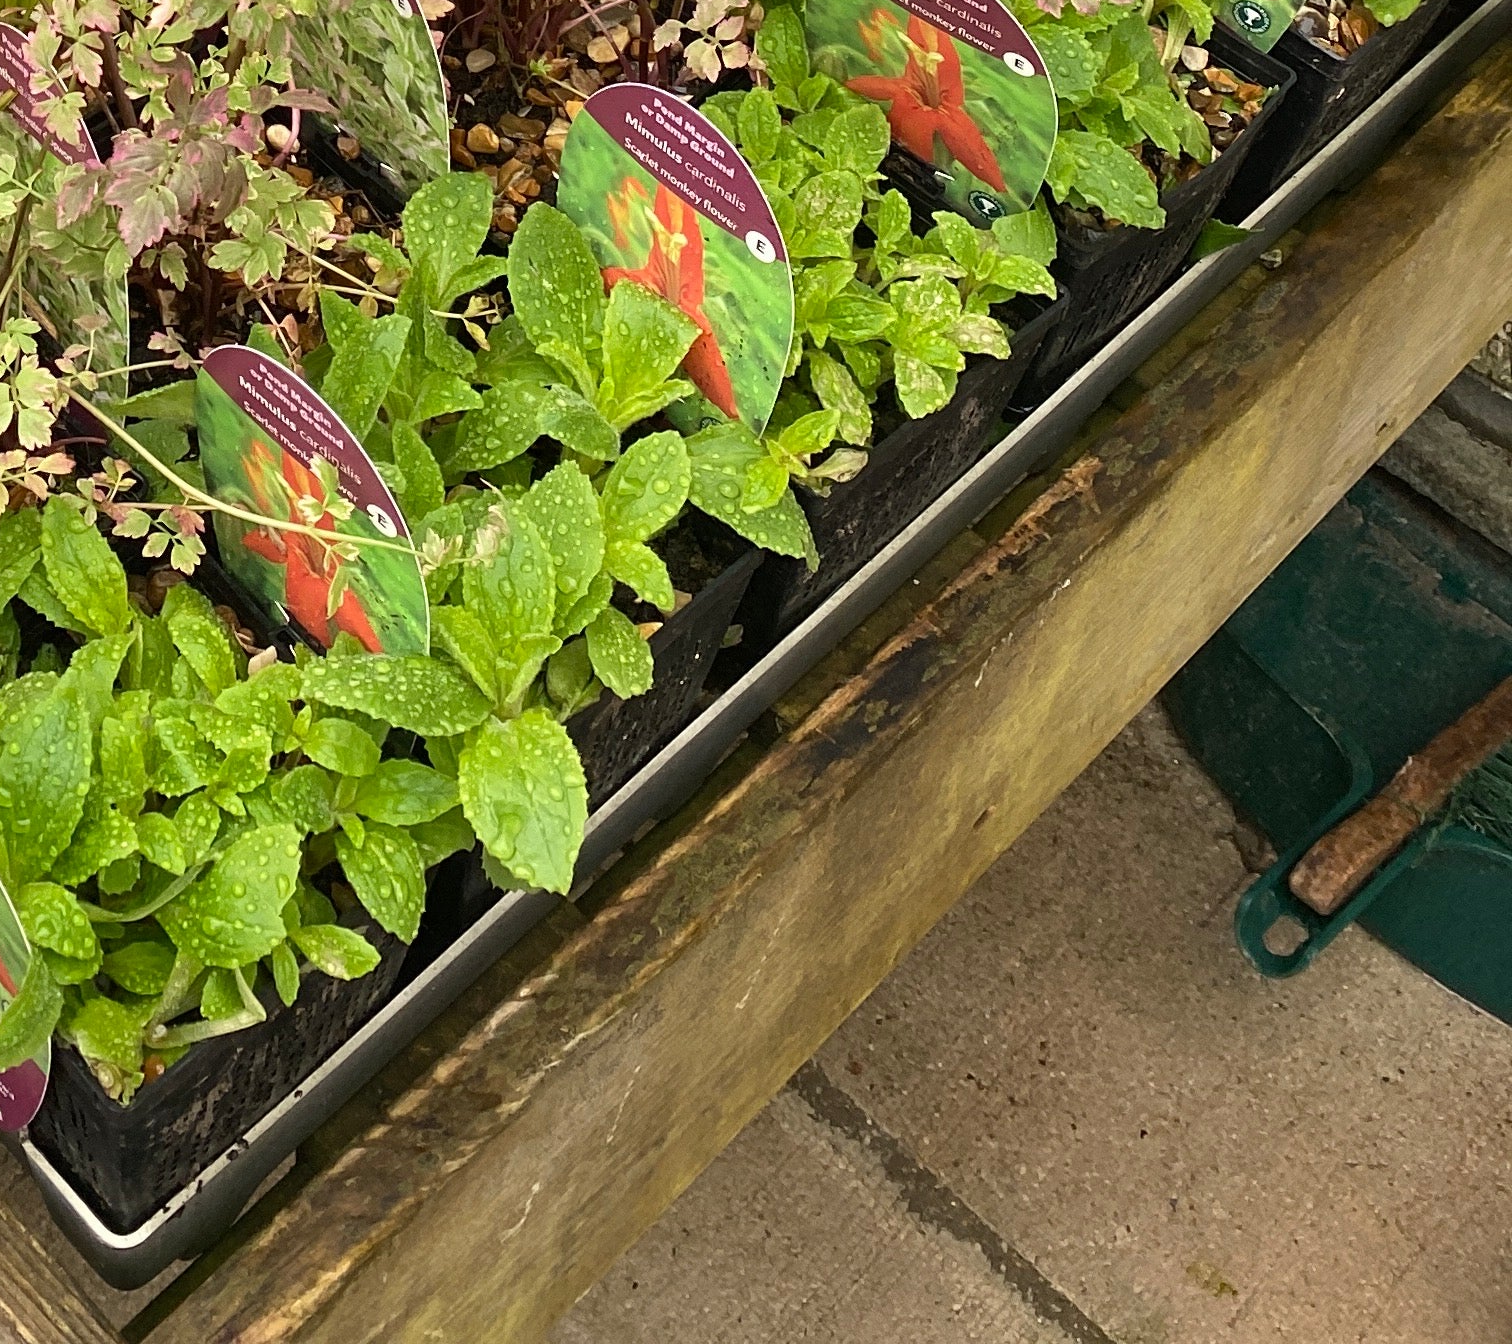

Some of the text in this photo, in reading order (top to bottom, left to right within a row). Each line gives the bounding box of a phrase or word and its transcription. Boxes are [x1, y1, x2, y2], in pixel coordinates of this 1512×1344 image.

[911, 2, 956, 32] monkey
[958, 27, 995, 53] flower
[1014, 59, 1024, 70] E
[641, 104, 735, 179] or Damp Ground
[654, 98, 725, 158] Pond Margin
[624, 137, 737, 231] Scarlet monkey flower
[625, 112, 746, 212] Mimulus cardinalis
[756, 240, 766, 254] E
[239, 376, 297, 432] Mimulus
[243, 401, 278, 437] Scarlet
[250, 369, 344, 450] or Damp Ground
[260, 363, 331, 429] Pond Margin
[377, 512, 388, 529] E
